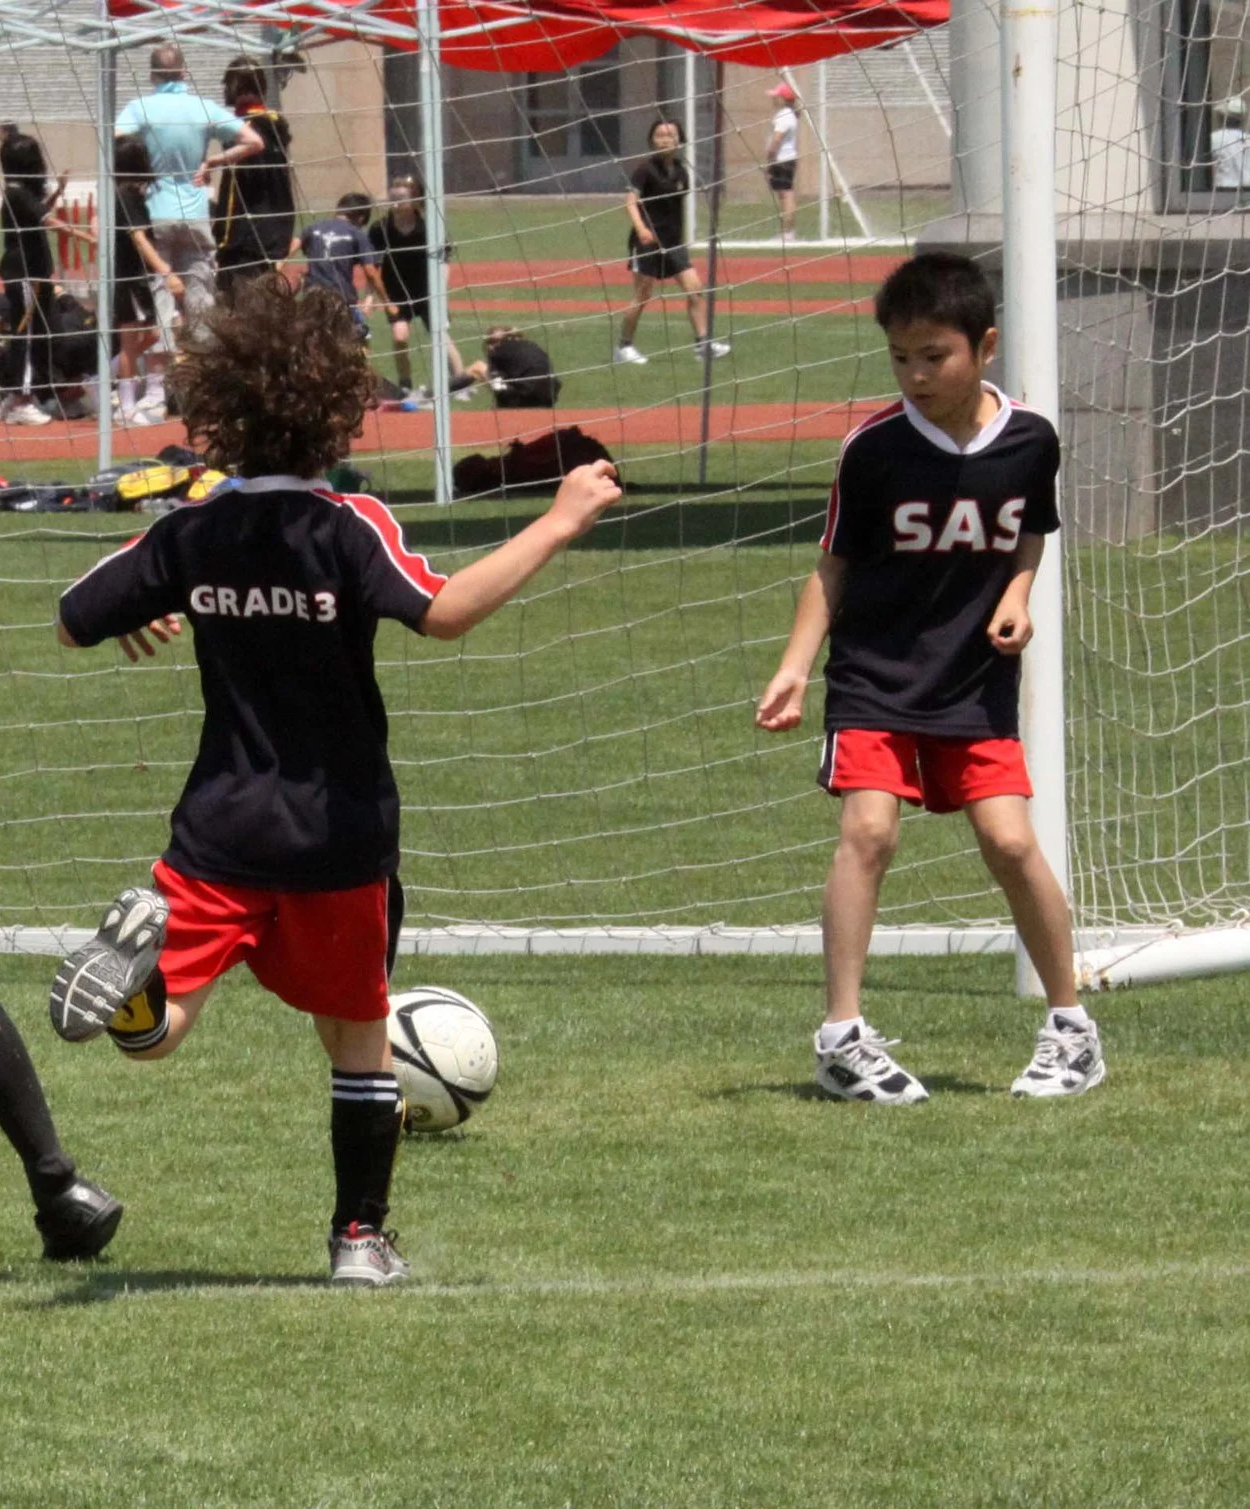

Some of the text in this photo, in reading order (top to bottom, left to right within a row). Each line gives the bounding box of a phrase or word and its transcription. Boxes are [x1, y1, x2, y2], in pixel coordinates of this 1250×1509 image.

[893, 497, 1026, 552] SAS
[190, 585, 338, 622] GRADE 3
